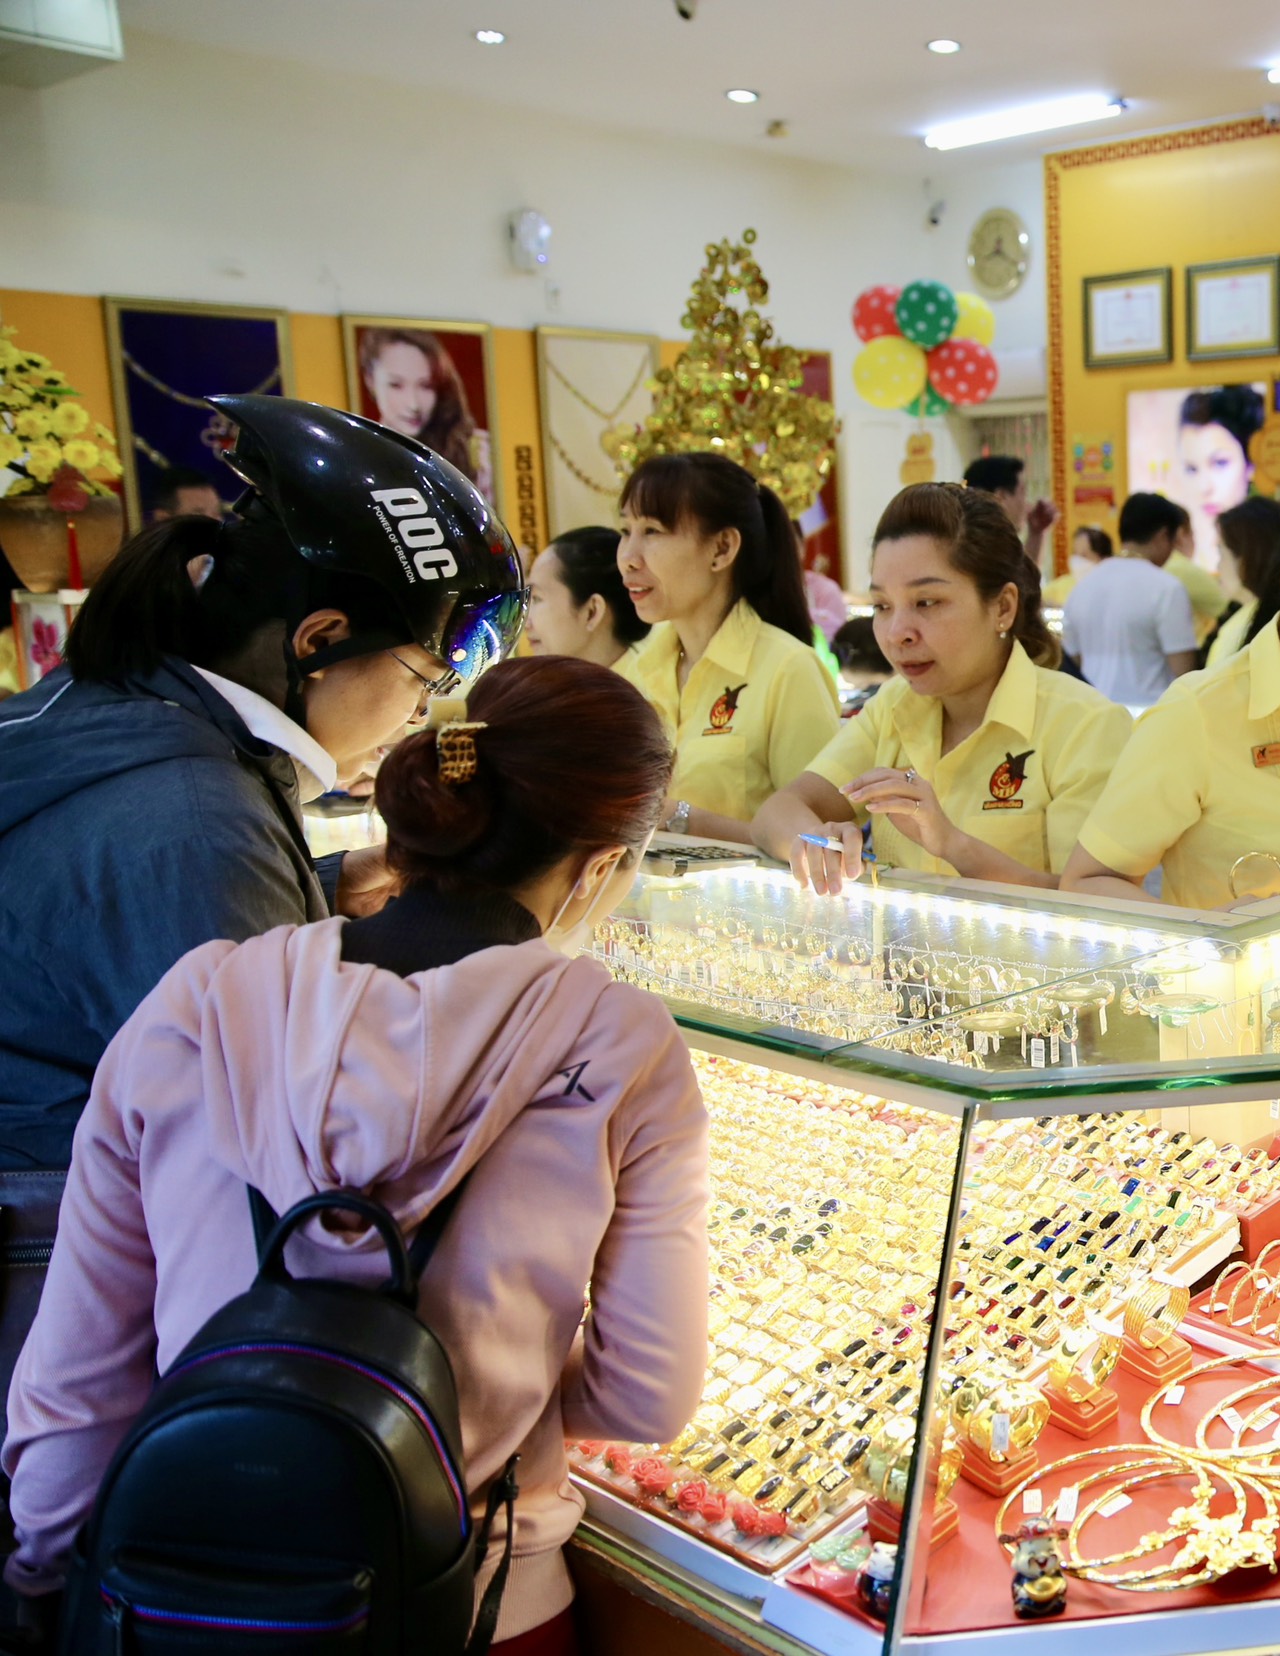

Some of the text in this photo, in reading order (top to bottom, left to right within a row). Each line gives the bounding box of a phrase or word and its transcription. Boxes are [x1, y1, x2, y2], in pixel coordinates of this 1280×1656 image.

[370, 487, 459, 581] POC
[372, 505, 417, 584] POWER OF CREATION
